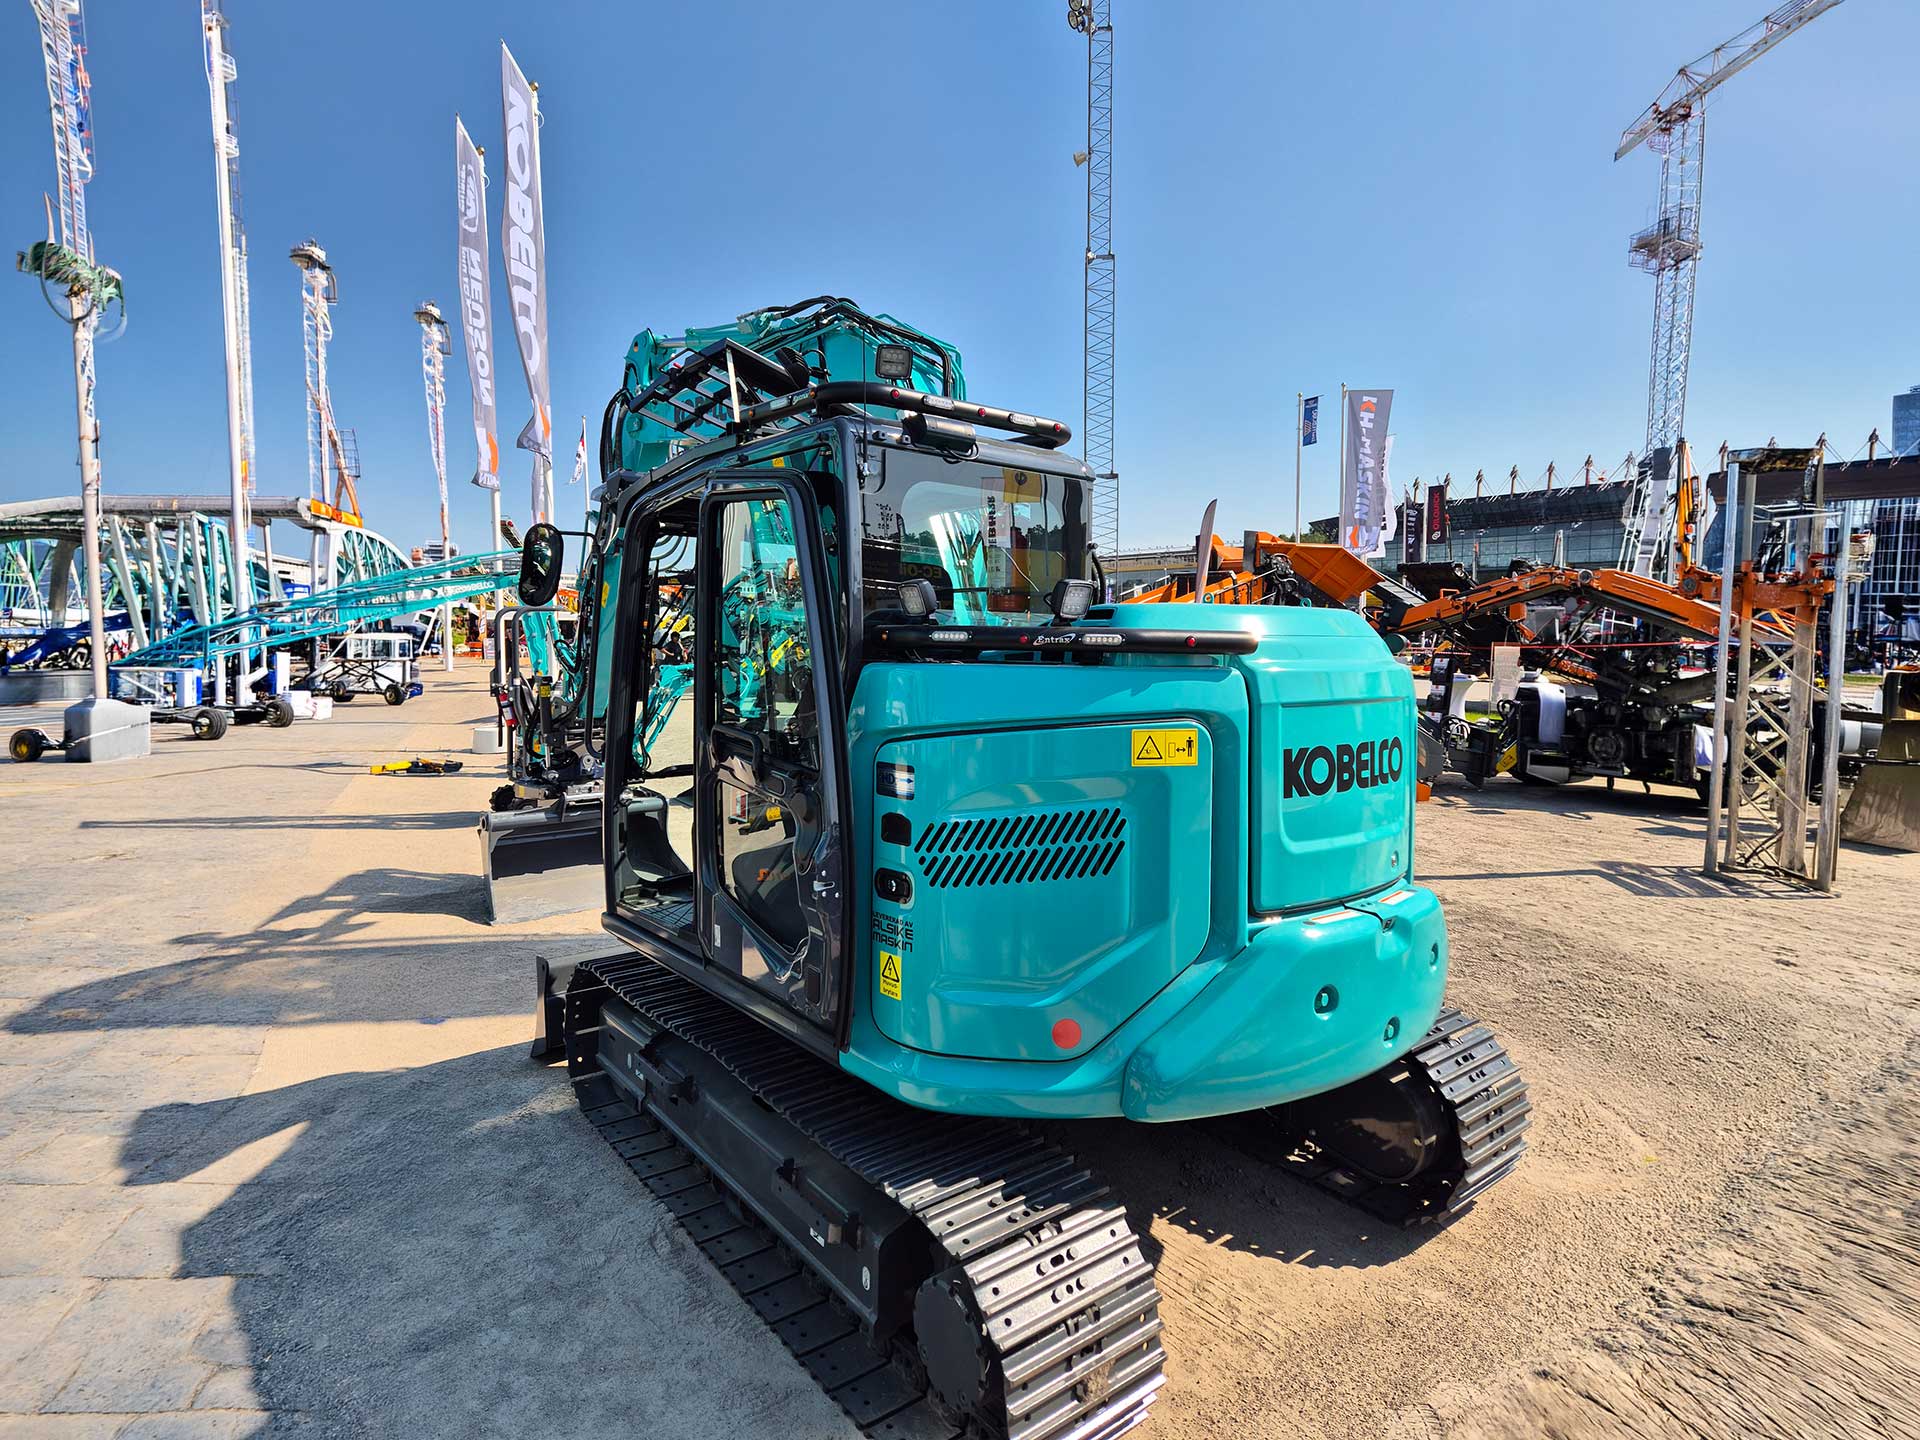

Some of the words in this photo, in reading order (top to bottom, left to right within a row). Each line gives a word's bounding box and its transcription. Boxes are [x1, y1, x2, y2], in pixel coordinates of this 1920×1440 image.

[1353, 395, 1378, 520] KH-MASKIN
[1035, 633, 1073, 645] Entrax
[1283, 736, 1403, 799] KOBELCO
[872, 918, 914, 941] ALSIKE
[904, 920, 914, 928] AV
[872, 931, 913, 952] MASKIN
